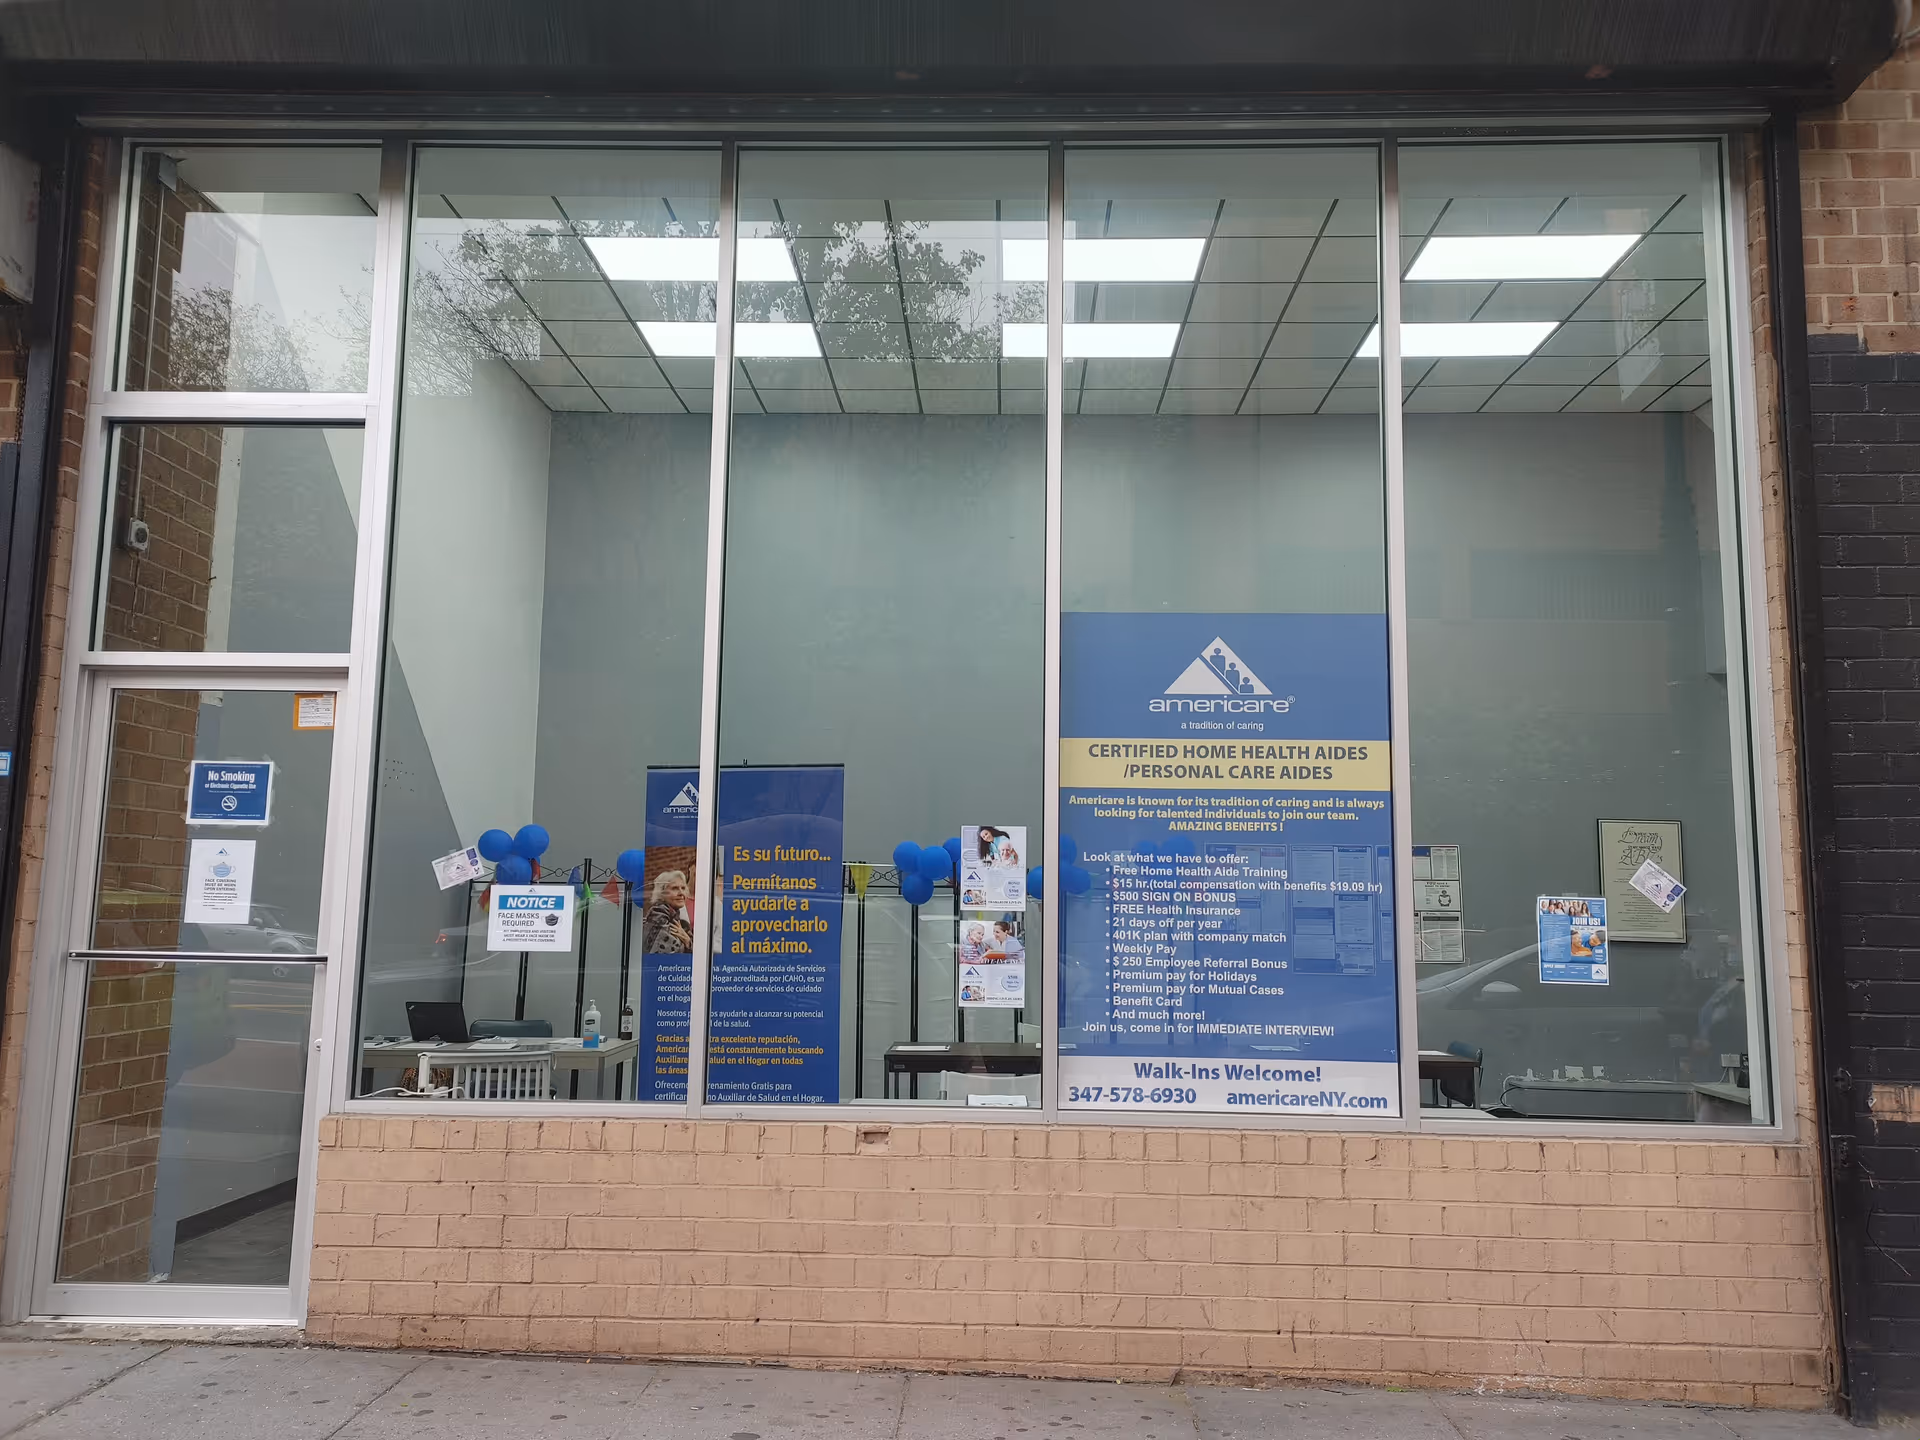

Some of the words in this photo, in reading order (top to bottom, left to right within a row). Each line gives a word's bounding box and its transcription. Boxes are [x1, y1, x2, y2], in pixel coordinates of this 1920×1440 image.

[1189, 720, 1225, 729] tradition
[1225, 720, 1234, 729] of
[1236, 720, 1263, 731] caring
[1088, 743, 1178, 758] CERTIFIED
[1183, 744, 1236, 759] HOME
[1241, 745, 1309, 759] HEALTH
[1314, 746, 1368, 760] AIDES
[208, 770, 219, 781] No
[221, 771, 255, 783] Smoking
[1123, 763, 1224, 779] /PERSONAL
[1228, 765, 1274, 779] CARE
[1279, 765, 1332, 780] AIDES
[1068, 794, 1124, 804] Americare
[1126, 795, 1135, 805] is
[1137, 795, 1174, 805] known
[1176, 796, 1193, 806] for
[1195, 796, 1208, 806] its
[1210, 796, 1259, 806] tradition
[1261, 796, 1273, 806] of
[1275, 796, 1309, 809] caring
[1312, 797, 1333, 807] and
[1335, 797, 1344, 807] is
[1346, 798, 1384, 810] always
[662, 806, 698, 814] americ
[1094, 807, 1135, 819] looking
[1137, 807, 1154, 817] for
[1156, 808, 1202, 818] talented
[1204, 808, 1266, 819] individuals
[1267, 810, 1279, 819] to
[1281, 808, 1301, 822] join
[1306, 811, 1325, 820] our
[1326, 811, 1359, 820] team.
[1168, 821, 1222, 830] AMAZING
[1224, 821, 1277, 831] BENEFITS
[733, 846, 750, 861] Es
[753, 849, 770, 861] su
[774, 844, 831, 861] futuro...
[1083, 851, 1110, 861] Look
[1113, 852, 1124, 862] at
[1126, 852, 1154, 862] what
[1175, 853, 1201, 863] have
[1204, 854, 1216, 863] to
[1218, 853, 1248, 864] offer:
[1113, 864, 1139, 875] Free
[1140, 865, 1172, 875] Home
[1176, 866, 1211, 876] Health
[1213, 866, 1239, 876] Aide
[1242, 866, 1287, 879] Training
[732, 873, 816, 889] Permítanos
[1112, 877, 1132, 888] $15
[1135, 878, 1176, 891] hr.(total
[1179, 879, 1255, 892] compensation
[1258, 880, 1280, 890] with
[1283, 880, 1326, 890] benefits
[1330, 880, 1364, 892] $19.09
[1367, 882, 1382, 893] hr)
[507, 897, 556, 908] NOTICE
[1112, 890, 1138, 901] $500
[1141, 891, 1170, 901] SIGN
[1173, 891, 1190, 901] ON
[1194, 892, 1236, 902] BONUS
[732, 895, 797, 914] ayudarle
[800, 898, 809, 910] a
[1113, 903, 1143, 914] FREE
[1147, 904, 1182, 914] Health
[1185, 905, 1240, 915] Insurance
[731, 915, 827, 935] aprovecharlo
[1112, 916, 1124, 926] 21
[1128, 917, 1155, 929] days
[1158, 917, 1174, 927] off
[1176, 920, 1195, 930] per
[1197, 920, 1222, 930] year
[1572, 917, 1587, 925] JOIN
[1112, 929, 1140, 940] 401K
[1143, 930, 1167, 942] plan
[1170, 931, 1194, 941] with
[1197, 933, 1248, 944] company
[1251, 932, 1286, 942] match
[731, 936, 745, 953] al
[748, 936, 812, 953] máximo.
[1112, 943, 1152, 955] Weekly
[1156, 943, 1176, 956] Pay
[657, 964, 692, 972] Americare
[721, 964, 748, 973] Agencia
[748, 964, 785, 972] Autorizada
[796, 964, 825, 972] Servicios
[1112, 955, 1119, 968] $
[1122, 956, 1142, 966] 250
[1145, 956, 1200, 969] Employee
[1203, 957, 1247, 968] Referral
[1251, 958, 1287, 968] Bonus
[712, 974, 732, 983] Hogar
[733, 974, 768, 982] acreditada
[782, 974, 805, 983] JCAHO,
[1112, 969, 1162, 980] Premium
[1165, 972, 1186, 982] pay
[1189, 970, 1205, 980] for
[1208, 970, 1256, 983] Holidays
[754, 984, 784, 992] servicios
[794, 984, 821, 992] cuidado
[1112, 982, 1162, 993] Premium
[1165, 985, 1186, 995] pay
[1188, 983, 1205, 993] for
[1208, 984, 1246, 994] Mutual
[1249, 984, 1284, 995] Cases
[1112, 995, 1152, 1006] Benefit
[1155, 994, 1182, 1006] Card
[718, 1009, 747, 1018] ayudarle
[754, 1009, 782, 1017] alcanzar
[793, 1009, 823, 1019] potencial
[1112, 1008, 1135, 1018] And
[1138, 1009, 1169, 1019] much
[1172, 1010, 1204, 1020] more!
[730, 1019, 750, 1027] salud.
[1082, 1021, 1106, 1031] Join
[1110, 1024, 1126, 1033] us,
[1130, 1024, 1160, 1032] come
[1164, 1022, 1174, 1032] in
[1177, 1022, 1193, 1033] for
[1196, 1023, 1261, 1034] IMMEDIATE
[1265, 1024, 1334, 1036] INTERVIEW!
[656, 1034, 684, 1042] Gracias
[720, 1034, 756, 1043] excelente
[757, 1034, 800, 1044] reputación,
[787, 1045, 823, 1054] buscando
[746, 1056, 769, 1066] Hogar
[1133, 1061, 1220, 1080] Walk-Ins
[1224, 1063, 1320, 1082] Welcome!
[718, 1093, 745, 1101] Auxiliar
[758, 1093, 780, 1102] Salud
[801, 1094, 824, 1104] Hogar.
[1068, 1086, 1196, 1103] 347-578-6930
[1226, 1088, 1387, 1108] americareNY.com
